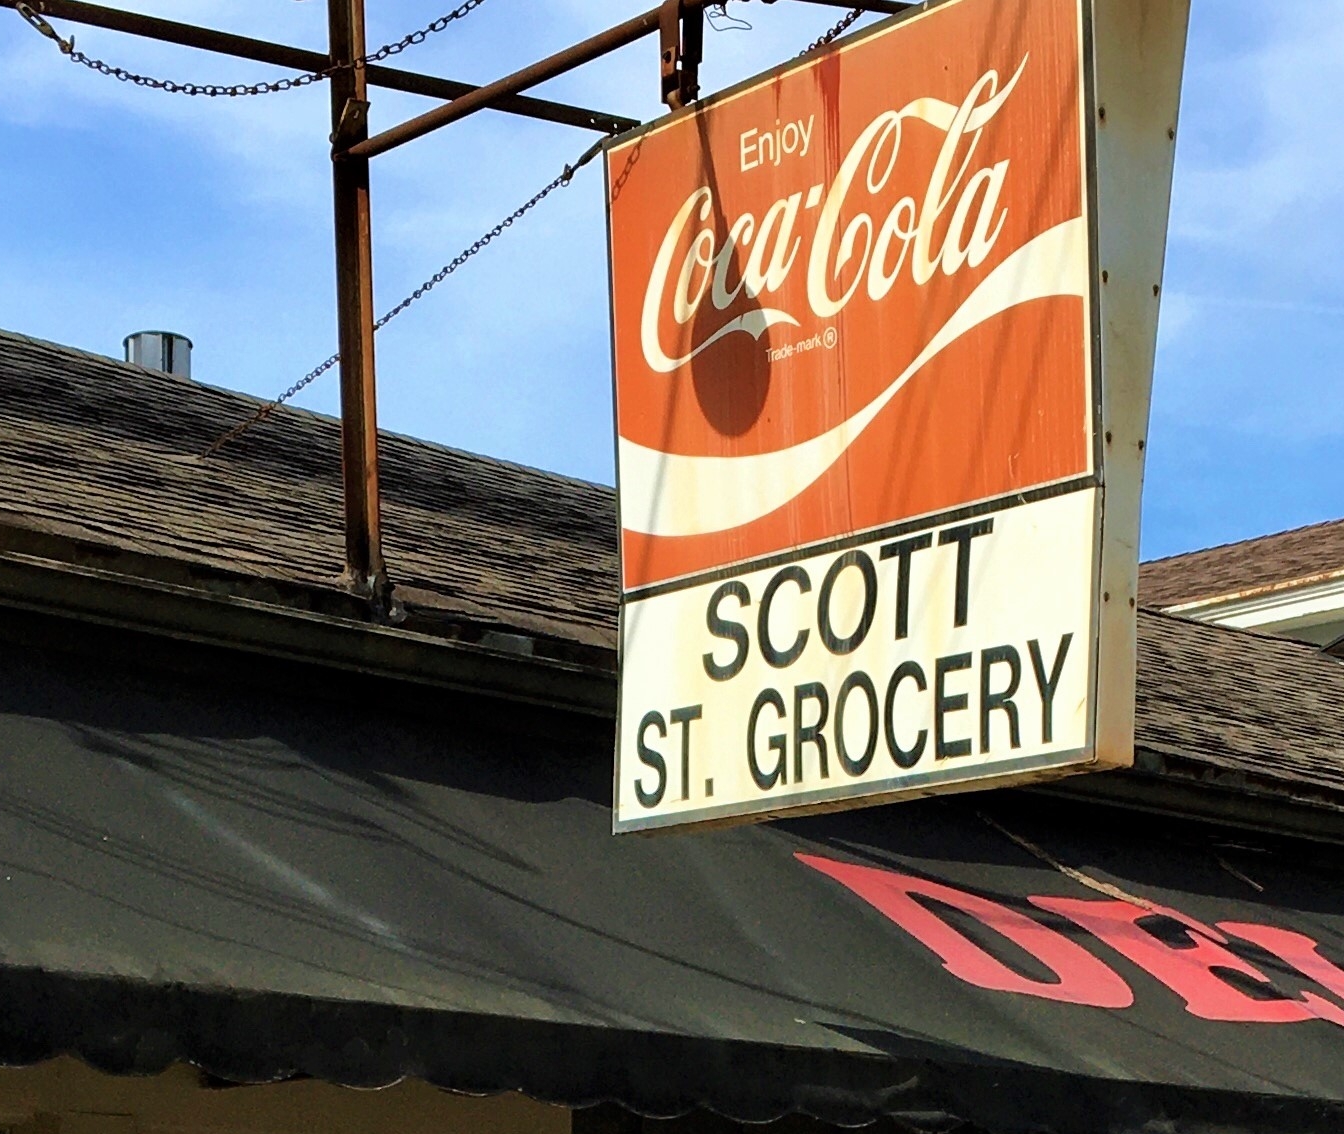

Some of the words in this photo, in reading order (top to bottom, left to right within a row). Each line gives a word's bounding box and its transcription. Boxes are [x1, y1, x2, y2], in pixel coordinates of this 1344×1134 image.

[640, 50, 1031, 374] Coca-Cola
[740, 114, 815, 173] Enjoy
[765, 333, 822, 363] Trade-mark
[702, 517, 994, 683] SCOTT
[633, 704, 715, 810] ST.
[746, 632, 1074, 792] GROCERY
